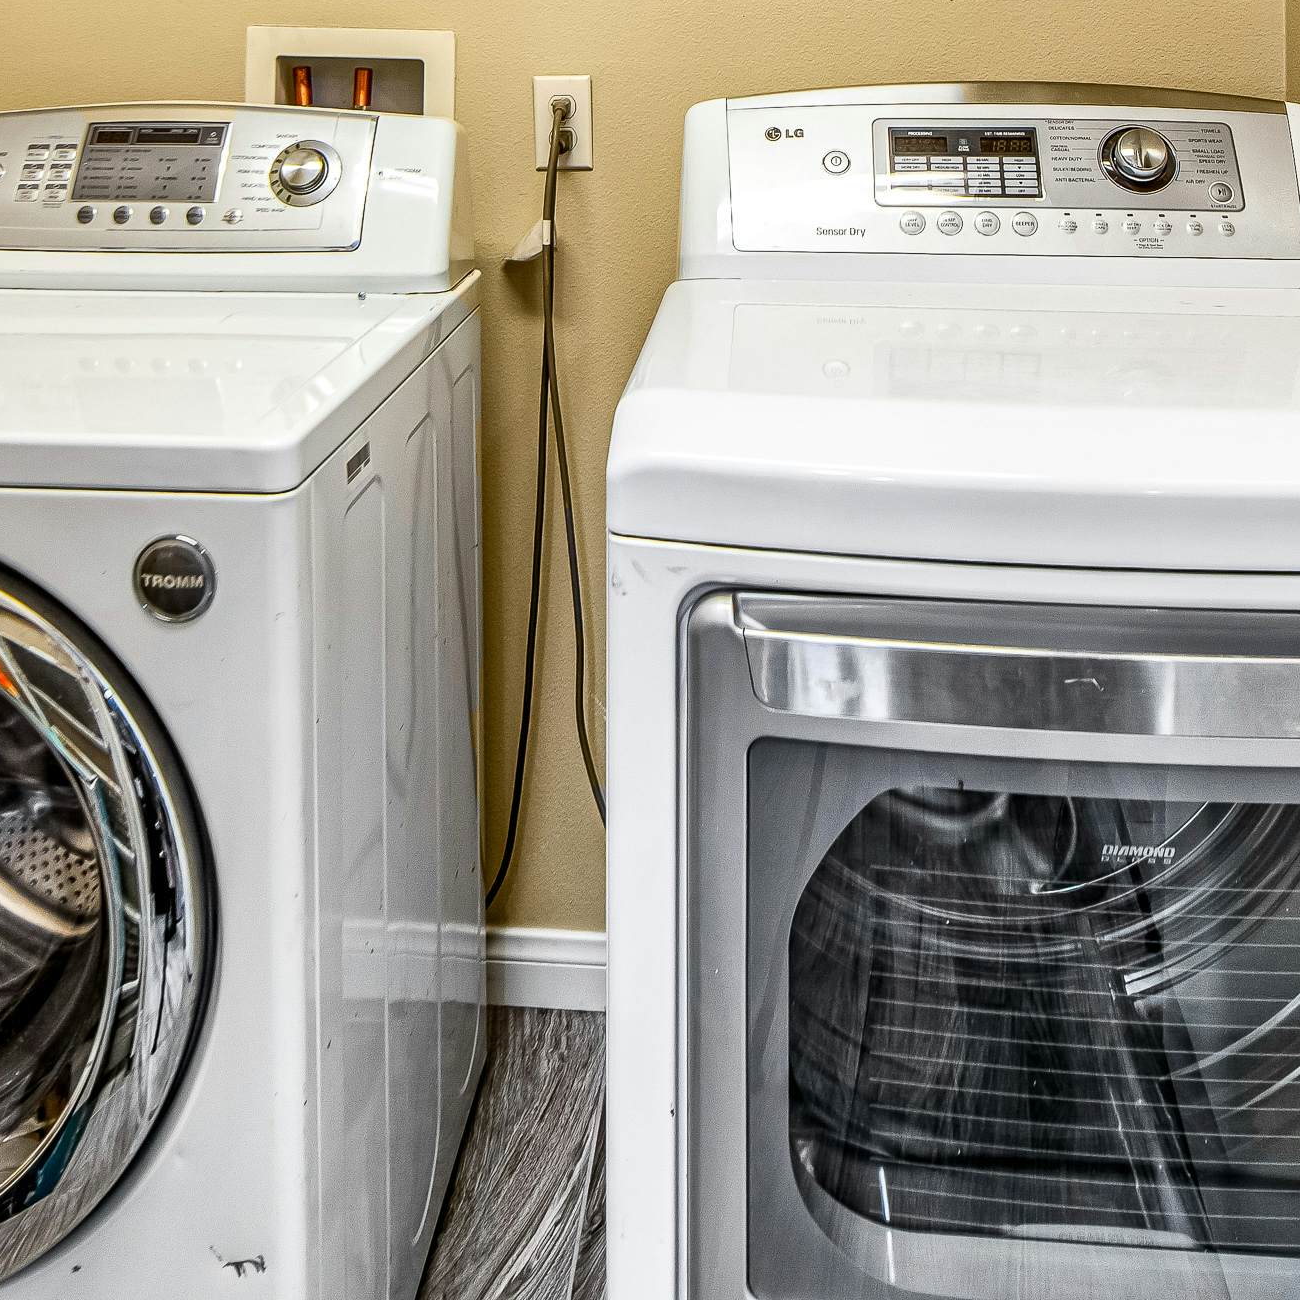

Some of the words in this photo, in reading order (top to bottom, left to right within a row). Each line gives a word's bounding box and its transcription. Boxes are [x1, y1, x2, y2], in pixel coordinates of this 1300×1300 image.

[785, 128, 804, 138] LG
[816, 227, 847, 236] Sensor
[849, 227, 866, 238] Dry
[140, 573, 205, 589] TROMM
[1102, 844, 1176, 858] DIAMOND
